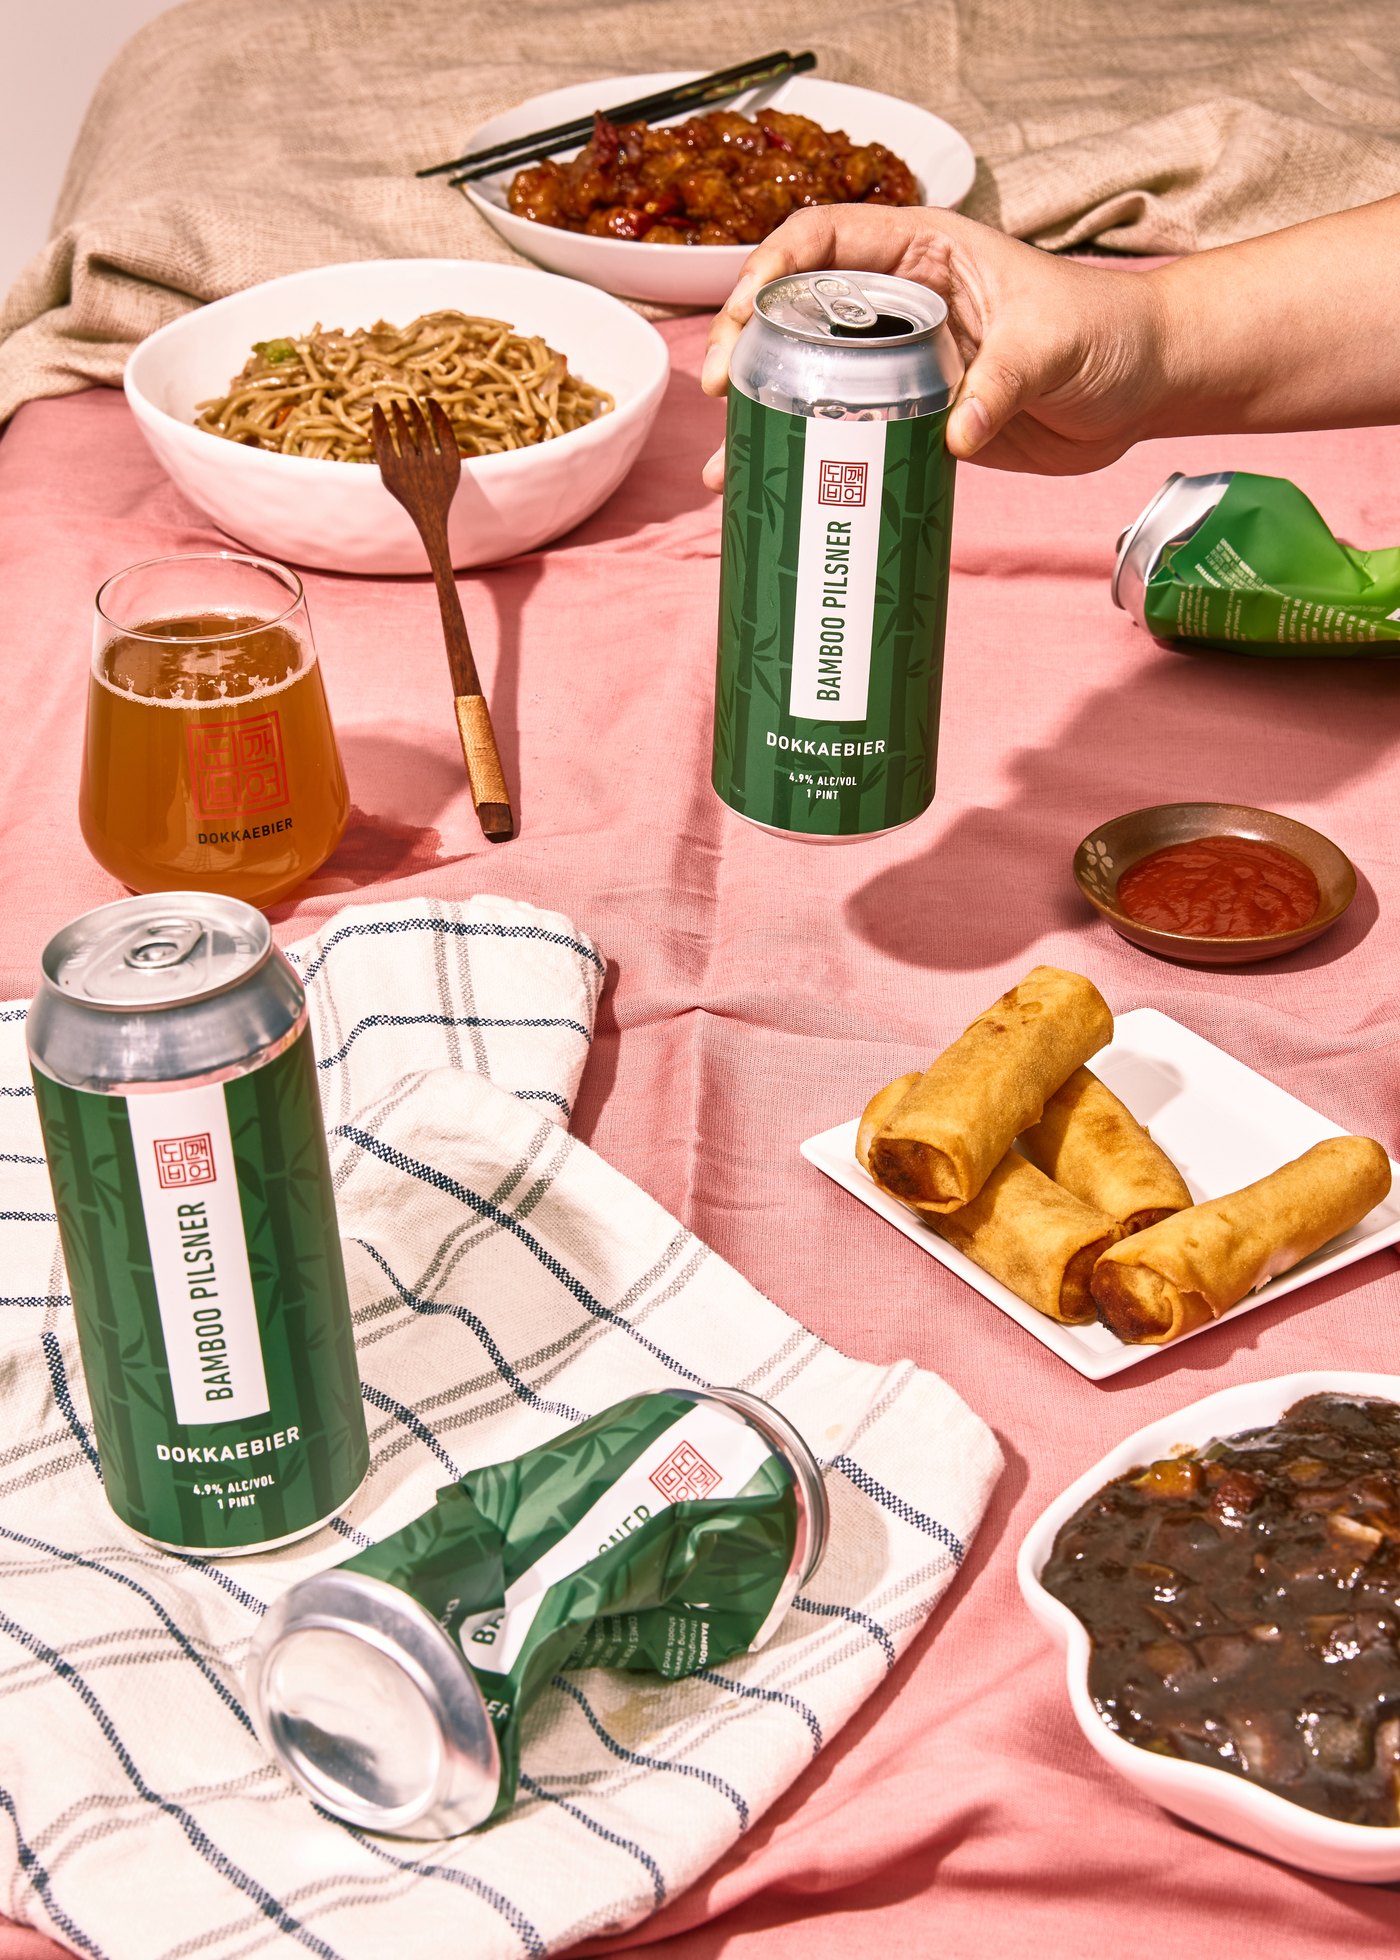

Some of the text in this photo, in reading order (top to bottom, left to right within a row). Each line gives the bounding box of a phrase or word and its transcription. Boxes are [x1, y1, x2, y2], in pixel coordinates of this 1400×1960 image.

[816, 520, 852, 701] BAMBOO PILSNER
[766, 731, 886, 757] DOKKAEBIER
[788, 770, 857, 788] 4.9% ALC/VOL
[806, 788, 839, 801] 1 PINT
[198, 817, 294, 846] DOKKAEBIER
[177, 1200, 234, 1402] BAMBOO PILSNER
[156, 1425, 301, 1464] DOKKAEBIER
[192, 1476, 275, 1496] 4.9% ALC/VOL
[217, 1494, 256, 1510] 1 PINT
[667, 1616, 676, 1647] shoots
[678, 1617, 687, 1646] young
[699, 1622, 710, 1664] BAMBOO
